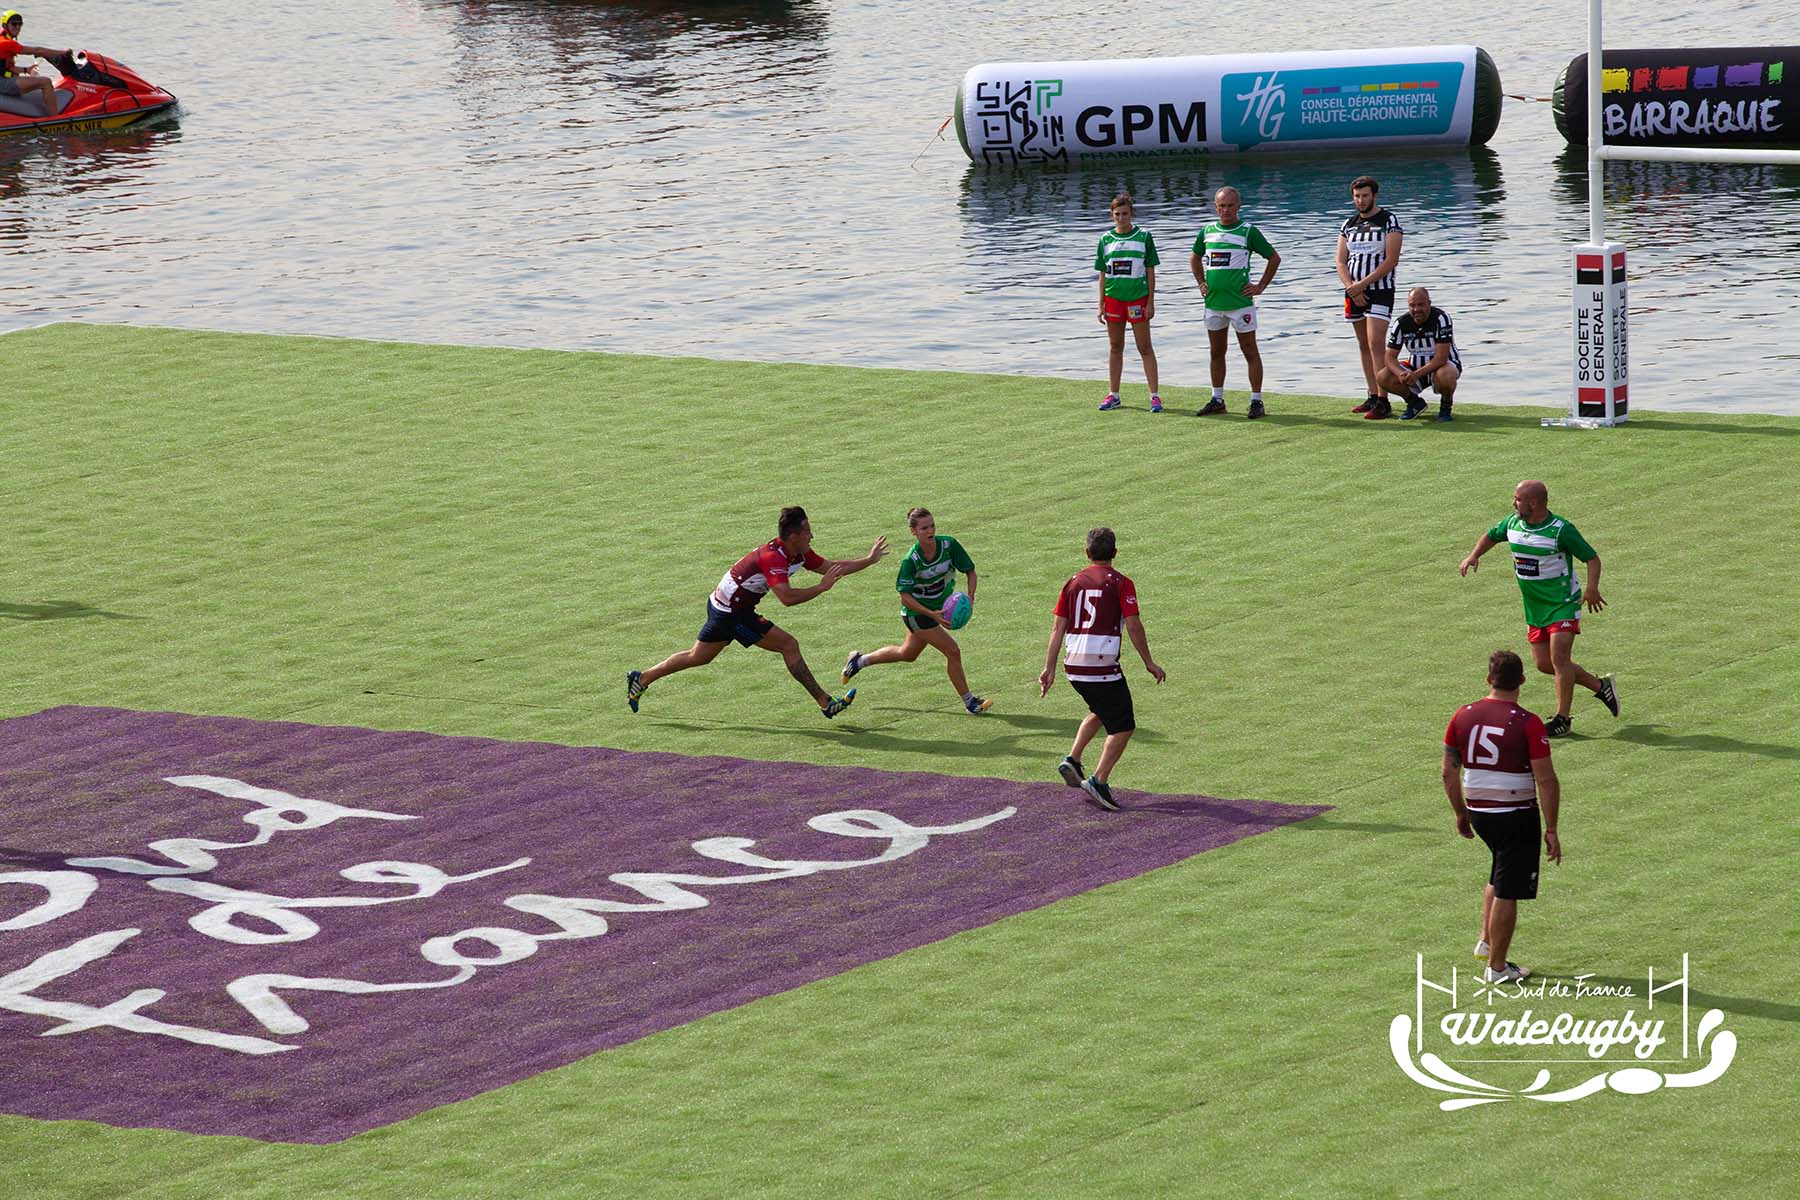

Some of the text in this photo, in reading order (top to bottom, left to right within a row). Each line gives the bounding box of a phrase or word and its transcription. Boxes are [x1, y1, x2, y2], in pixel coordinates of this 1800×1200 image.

[1301, 93, 1437, 110] CONSEIL DÉPARTEMENTAL
[1301, 104, 1438, 125] HAUTE-GARONNE.FR
[1602, 96, 1783, 138] BARRAQUE
[1075, 101, 1207, 148] GPM
[1578, 308, 1590, 381] SOCIETE
[1593, 291, 1605, 382] GENERALE
[1612, 307, 1620, 381] SOCIETE
[1074, 589, 1103, 629] 15
[1467, 724, 1505, 766] 15
[147, 857, 533, 945] de
